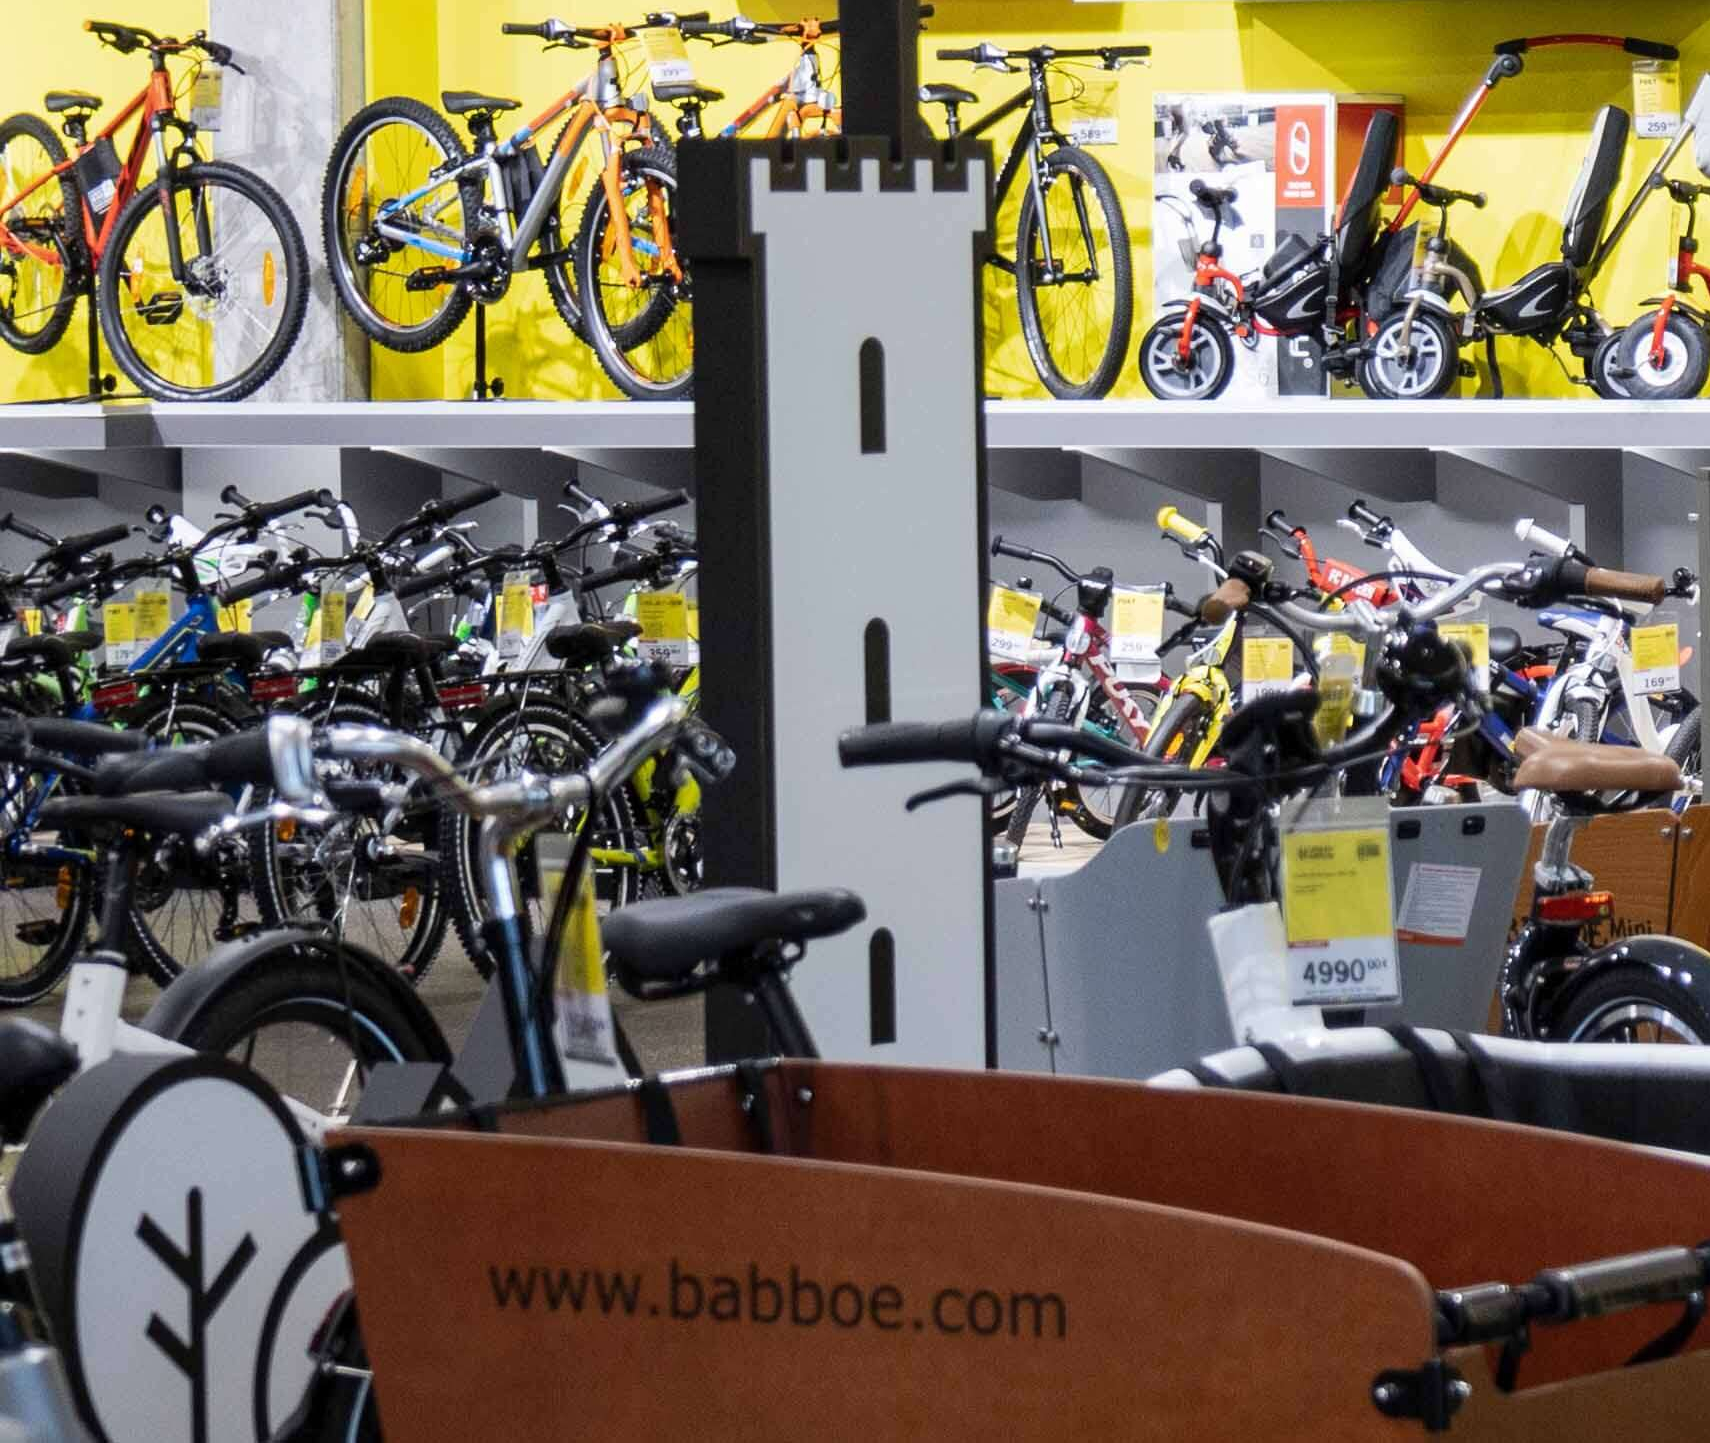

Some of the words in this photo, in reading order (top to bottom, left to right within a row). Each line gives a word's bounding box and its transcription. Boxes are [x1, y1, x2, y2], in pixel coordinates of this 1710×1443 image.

[1647, 121, 1667, 133] 259
[1643, 675, 1665, 689] 169
[1302, 958, 1365, 986] 4990
[490, 1259, 1068, 1338] www.babboe.com
